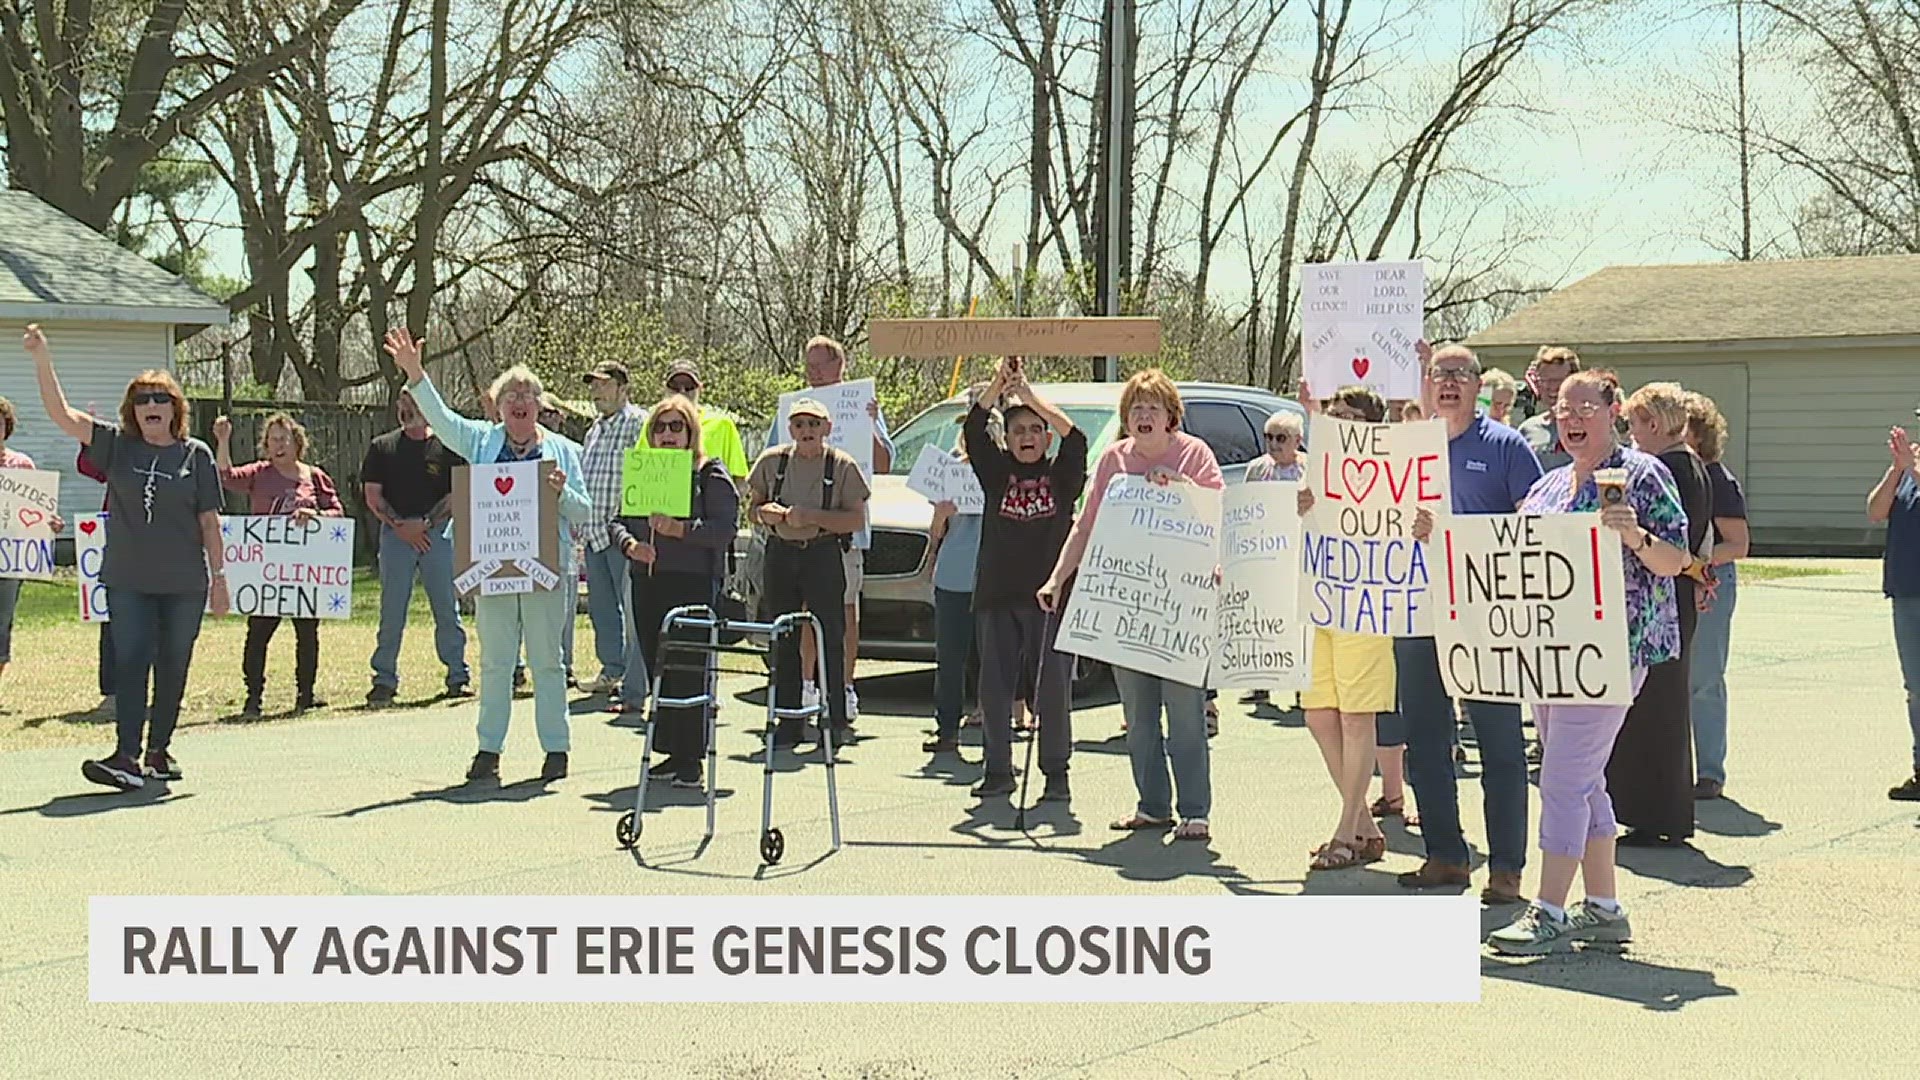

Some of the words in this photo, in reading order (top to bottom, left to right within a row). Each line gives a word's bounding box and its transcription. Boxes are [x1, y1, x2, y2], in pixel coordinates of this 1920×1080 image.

[1375, 270, 1406, 280] DEAR
[1366, 304, 1395, 315] HELP
[1338, 424, 1391, 456] WE
[243, 517, 321, 545] KEEP
[487, 511, 521, 523] DEAR
[1130, 507, 1216, 539] Mission
[1339, 507, 1404, 537] OUR
[1490, 515, 1543, 547] WE
[225, 544, 263, 563] OUR
[478, 543, 509, 554] HELP
[1303, 532, 1429, 585] MEDICA
[263, 563, 349, 586] CLINIC
[460, 559, 500, 592] PLEASE
[1088, 546, 1168, 589] Honesty
[1180, 570, 1217, 594] and
[1465, 550, 1575, 604] NEED
[237, 583, 317, 616] OPEN
[1079, 574, 1182, 625] Integrity
[1191, 607, 1208, 621] in
[1309, 581, 1427, 635] STAFF
[1069, 608, 1103, 633] ALL
[1115, 616, 1211, 659] DEALINGS
[1489, 604, 1555, 638] OUR
[1220, 639, 1294, 670] Solutions
[1450, 643, 1608, 698] CLINIC
